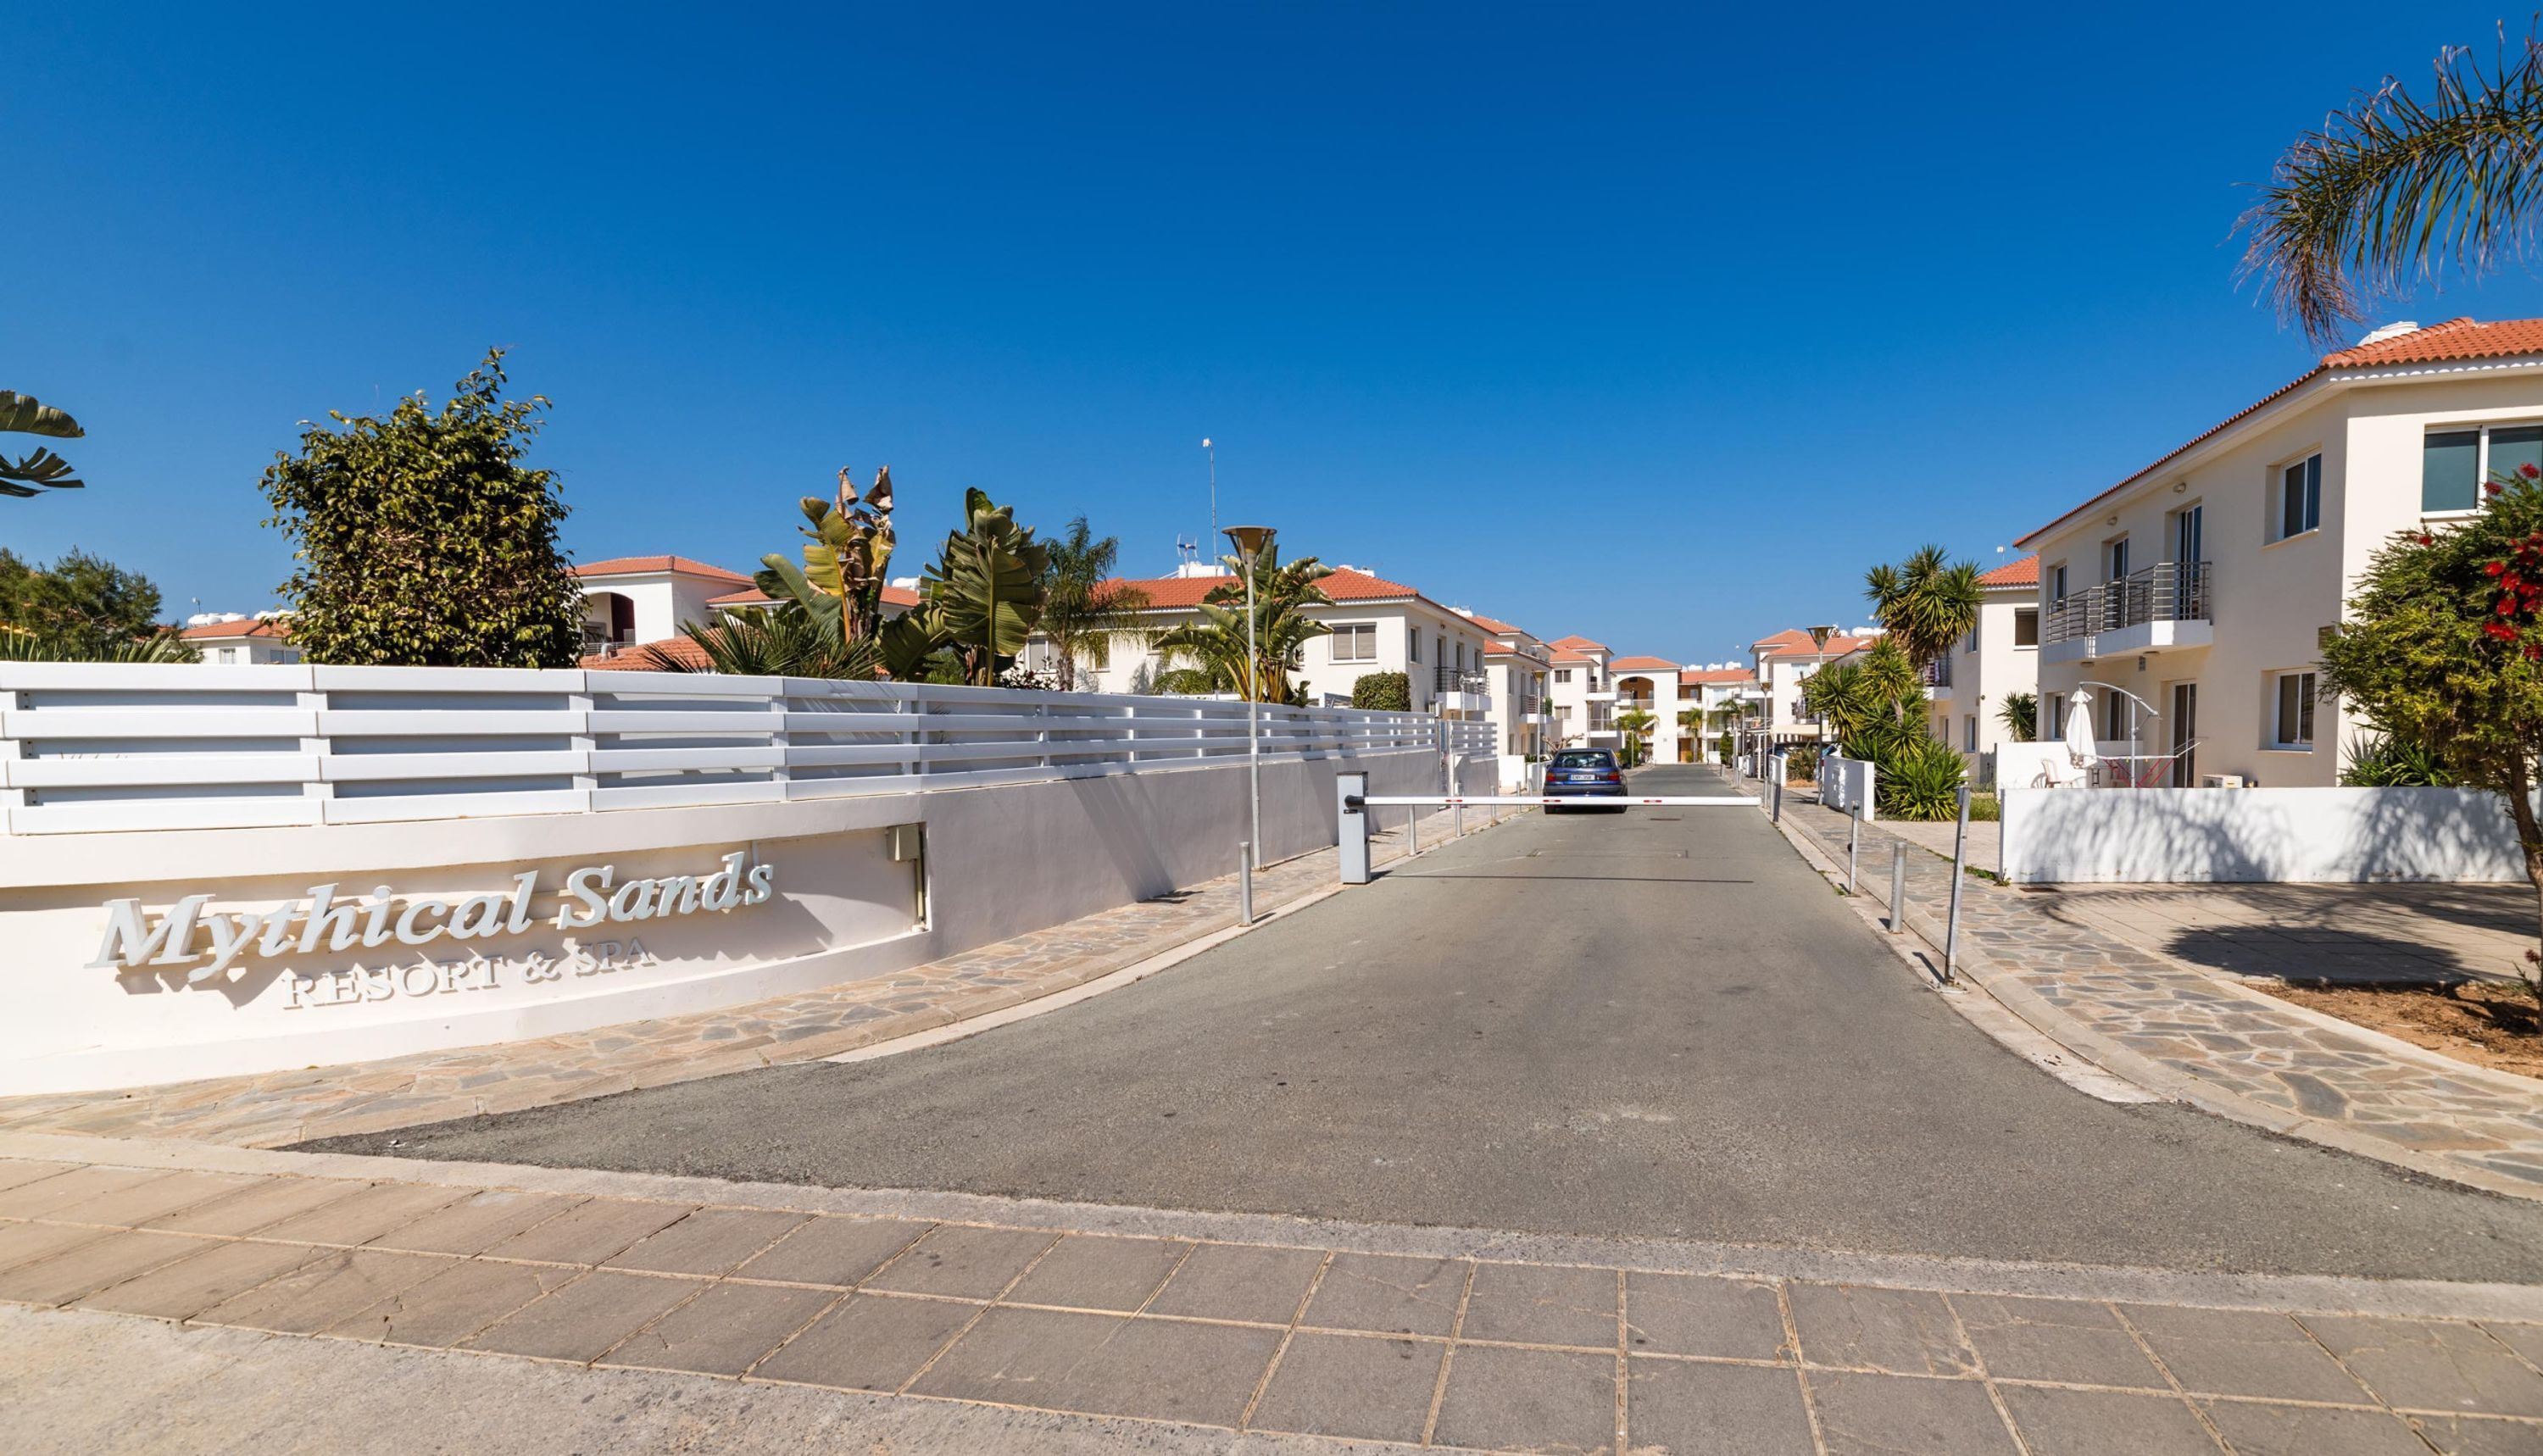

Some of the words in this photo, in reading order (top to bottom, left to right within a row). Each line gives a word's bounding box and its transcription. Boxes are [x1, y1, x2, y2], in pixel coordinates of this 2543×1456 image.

[84, 870, 538, 983] Mythical
[556, 851, 773, 930] Sands
[283, 955, 504, 1009] RESORT
[521, 950, 559, 982] &
[570, 938, 656, 975] SPA
